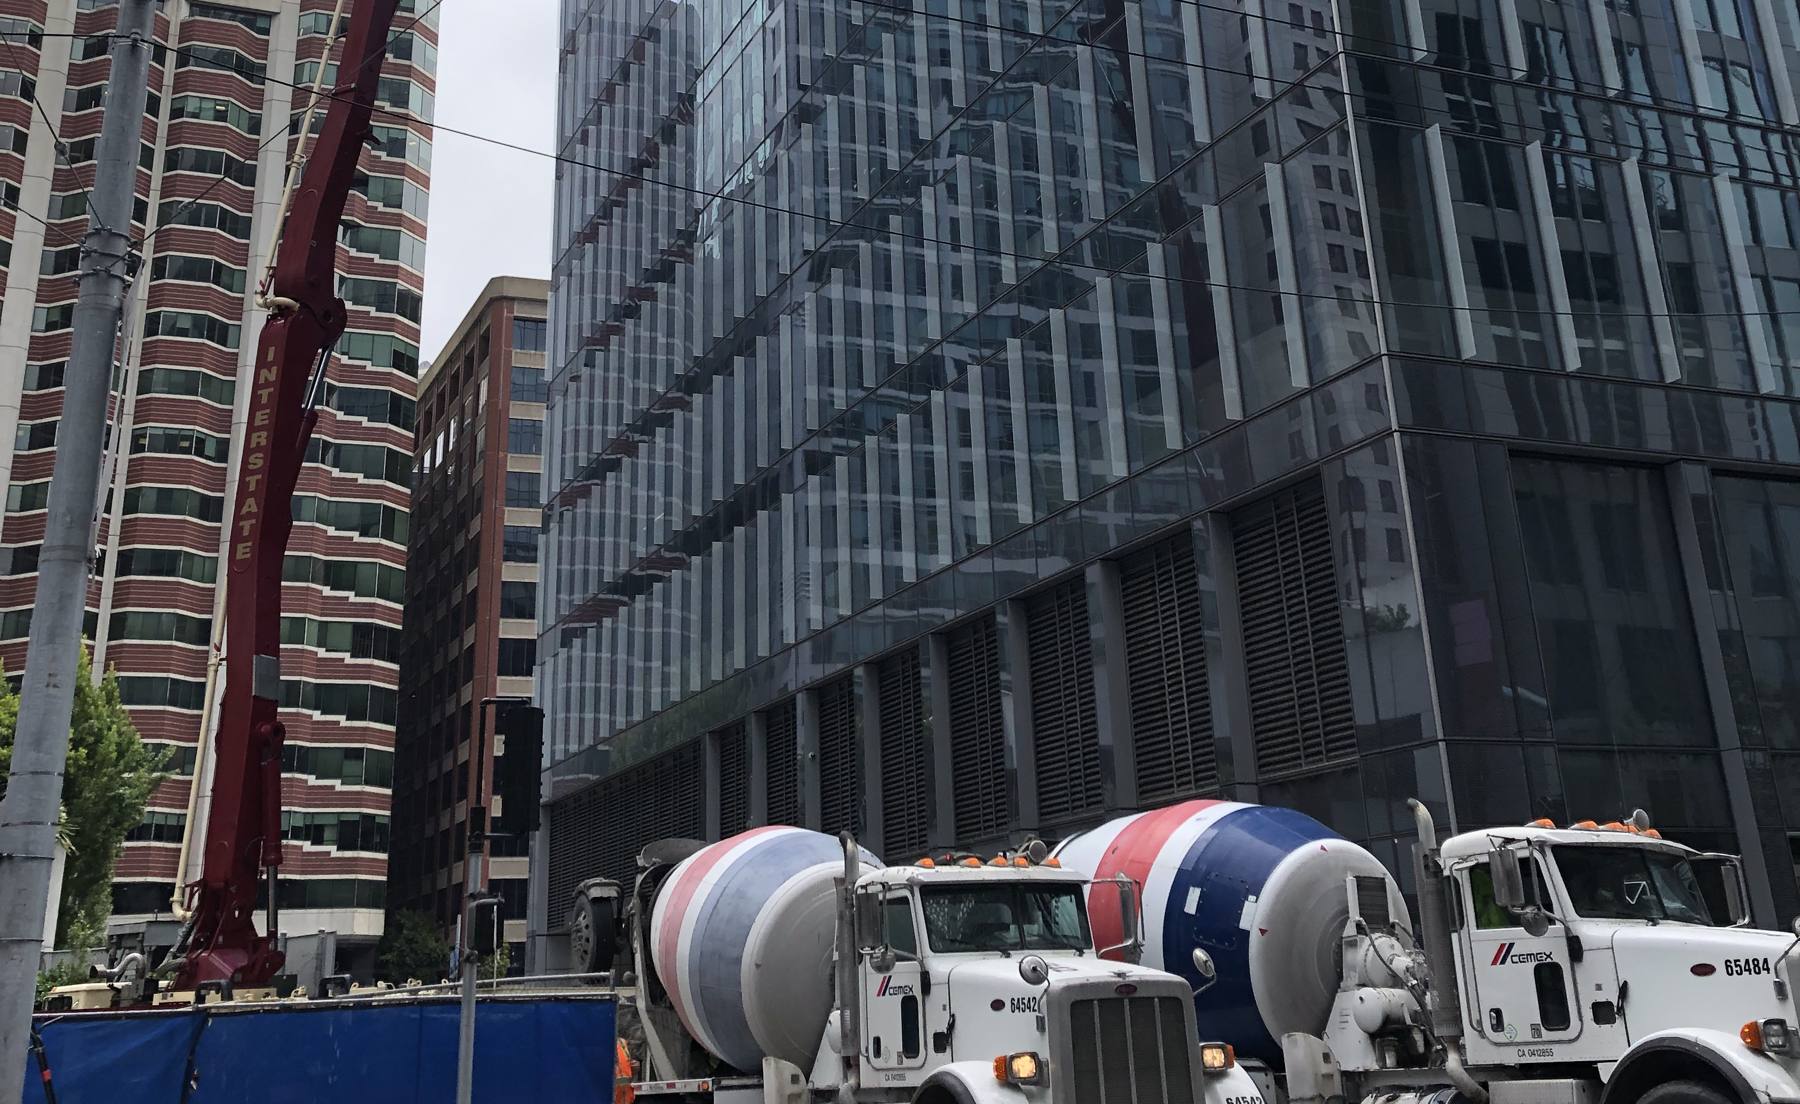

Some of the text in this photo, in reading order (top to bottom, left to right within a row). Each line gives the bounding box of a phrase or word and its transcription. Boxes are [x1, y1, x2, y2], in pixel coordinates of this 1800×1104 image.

[235, 346, 278, 560] INTERSTATE
[1510, 951, 1553, 964] CEMEX
[1724, 957, 1771, 977] 65484
[888, 984, 914, 996] CEMEX
[1010, 997, 1038, 1014] 64542
[1517, 1048, 1526, 1057] CA
